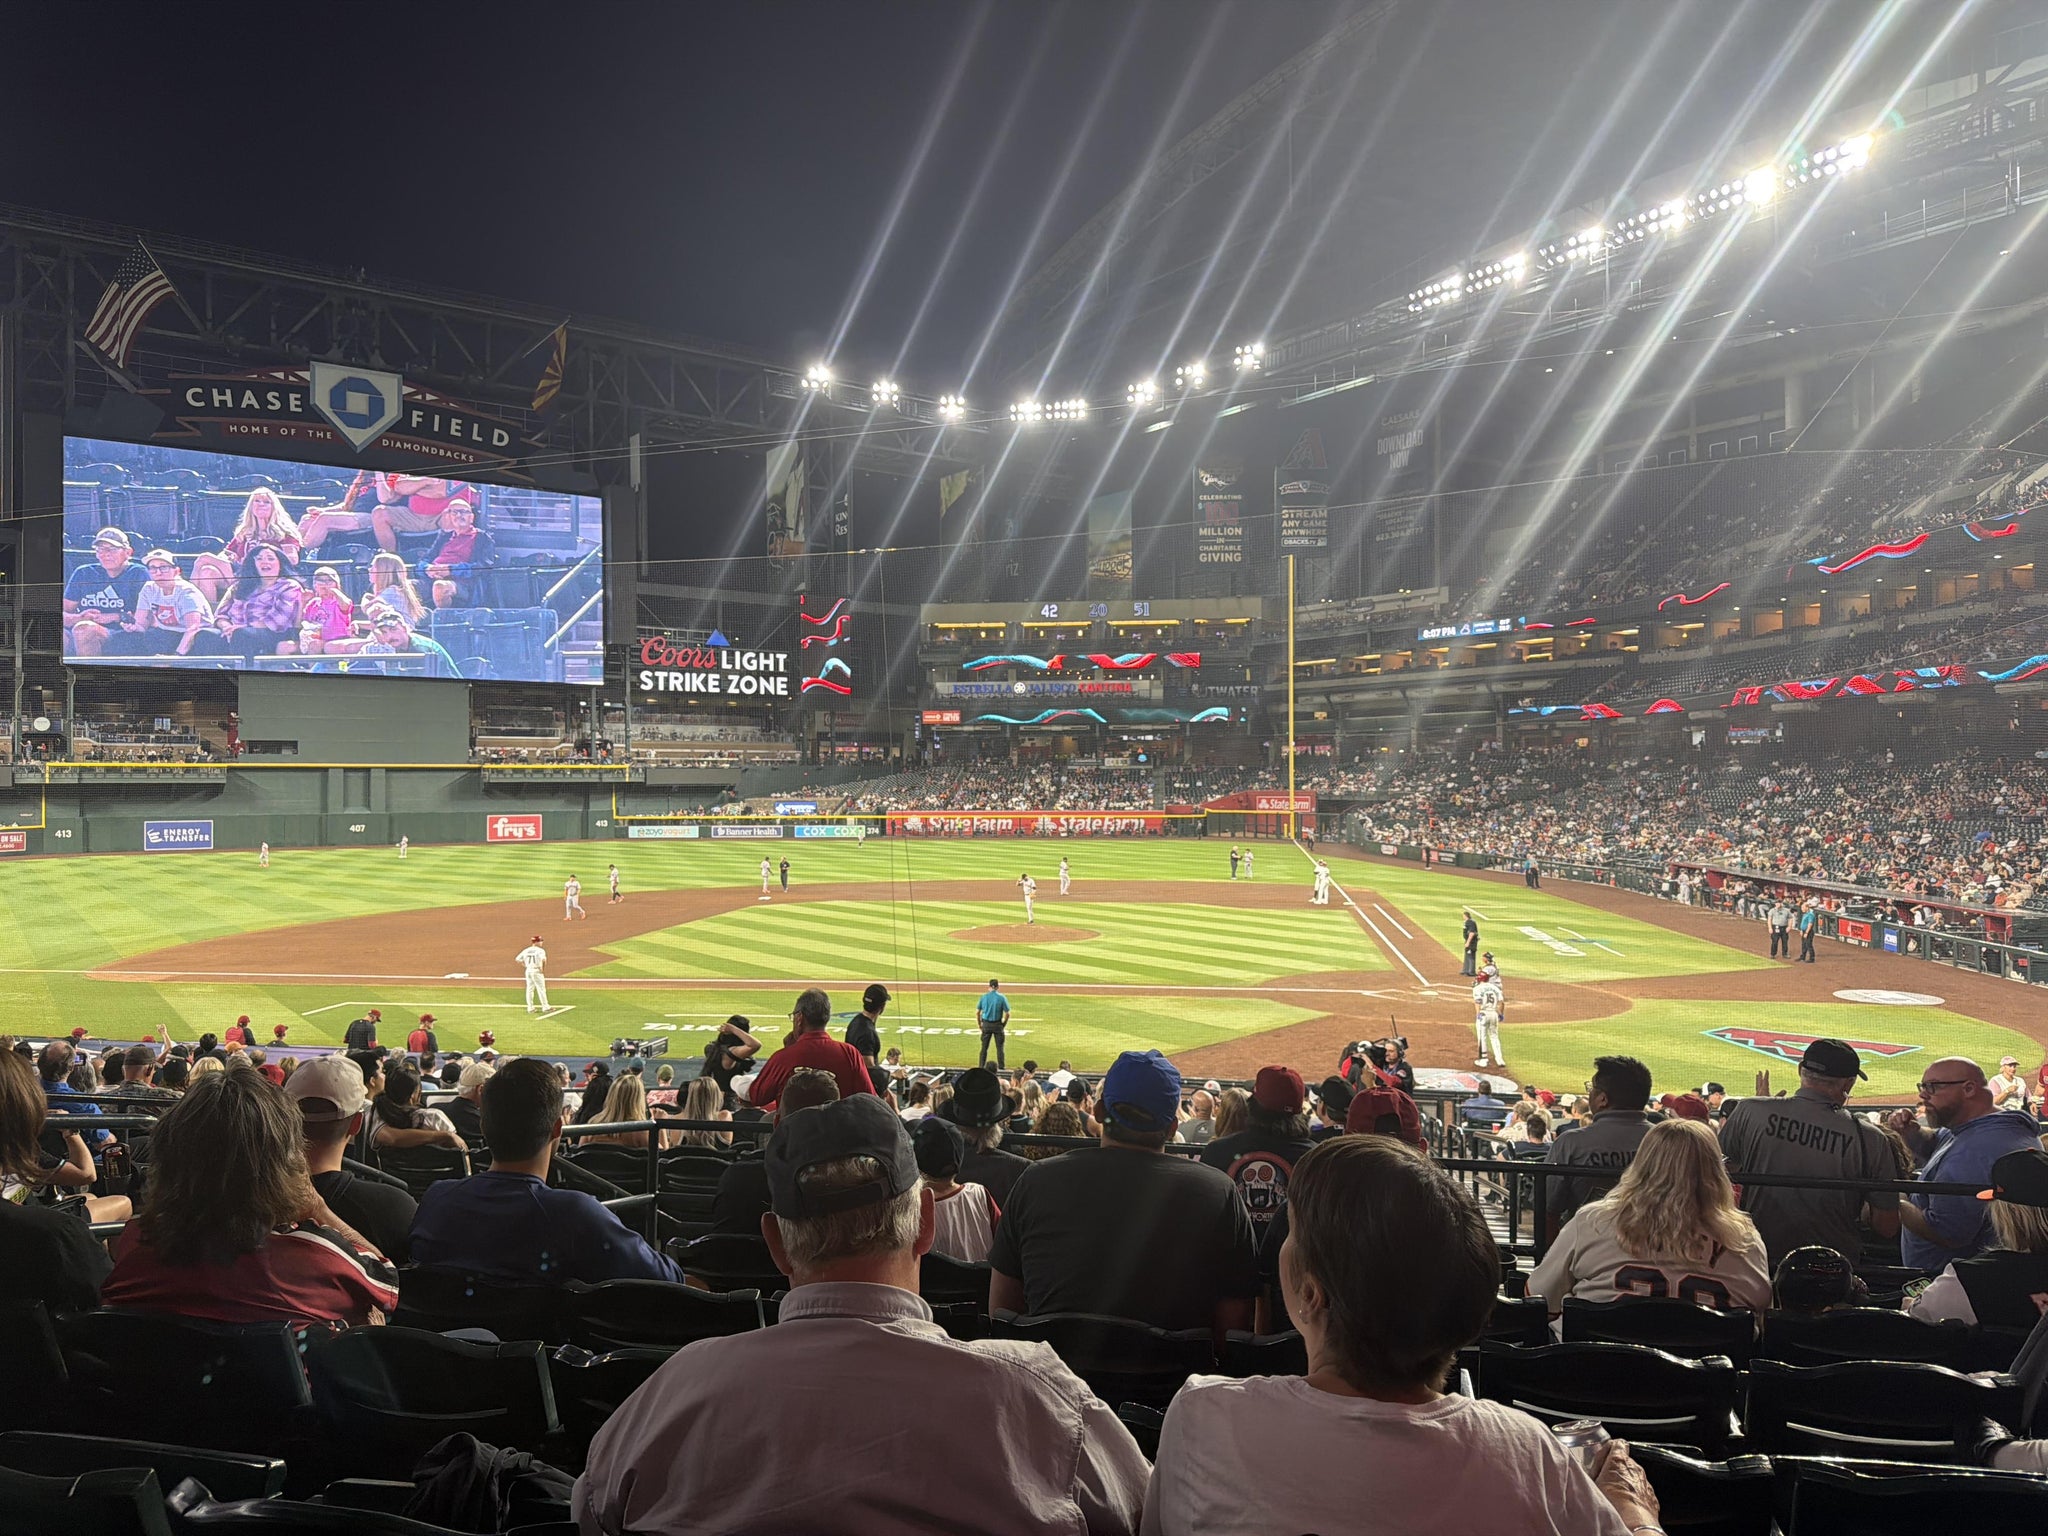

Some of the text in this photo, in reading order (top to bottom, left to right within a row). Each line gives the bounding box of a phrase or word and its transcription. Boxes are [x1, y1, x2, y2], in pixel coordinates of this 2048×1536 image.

[185, 387, 509, 447] CHASE FIELD
[229, 425, 474, 462] HOME OF THE DIAMONDBACKS
[1377, 429, 1424, 455] DOWNLOAD
[1389, 450, 1410, 470] NOW
[1281, 509, 1328, 518] STREAM
[1281, 519, 1328, 527] ANY GAME
[1199, 527, 1242, 536] MILLION
[1199, 553, 1242, 562] GIVING
[81, 597, 124, 608] adidas
[1041, 604, 1058, 618] 42
[1089, 603, 1108, 617] 20
[1133, 602, 1150, 616] 51
[1422, 626, 1456, 638] 8:07 PM
[640, 636, 788, 671] Coors LIGHT
[640, 670, 788, 695] STRIKE ZONE
[953, 684, 1012, 694] ESTRELLA
[1079, 682, 1133, 693] CANTINA
[1270, 798, 1290, 809] State
[349, 824, 366, 833] 407
[492, 817, 536, 838] fry's
[595, 820, 609, 828] 413
[973, 817, 1013, 831] Farm
[55, 829, 72, 838] 413
[163, 828, 201, 836] ENERGY
[726, 827, 777, 836] Banner Health
[803, 827, 826, 836] COX
[834, 827, 856, 836] COX
[9, 834, 23, 842] SALE
[164, 834, 210, 842] TRANSFER
[1765, 1112, 1854, 1158] SECURITY
